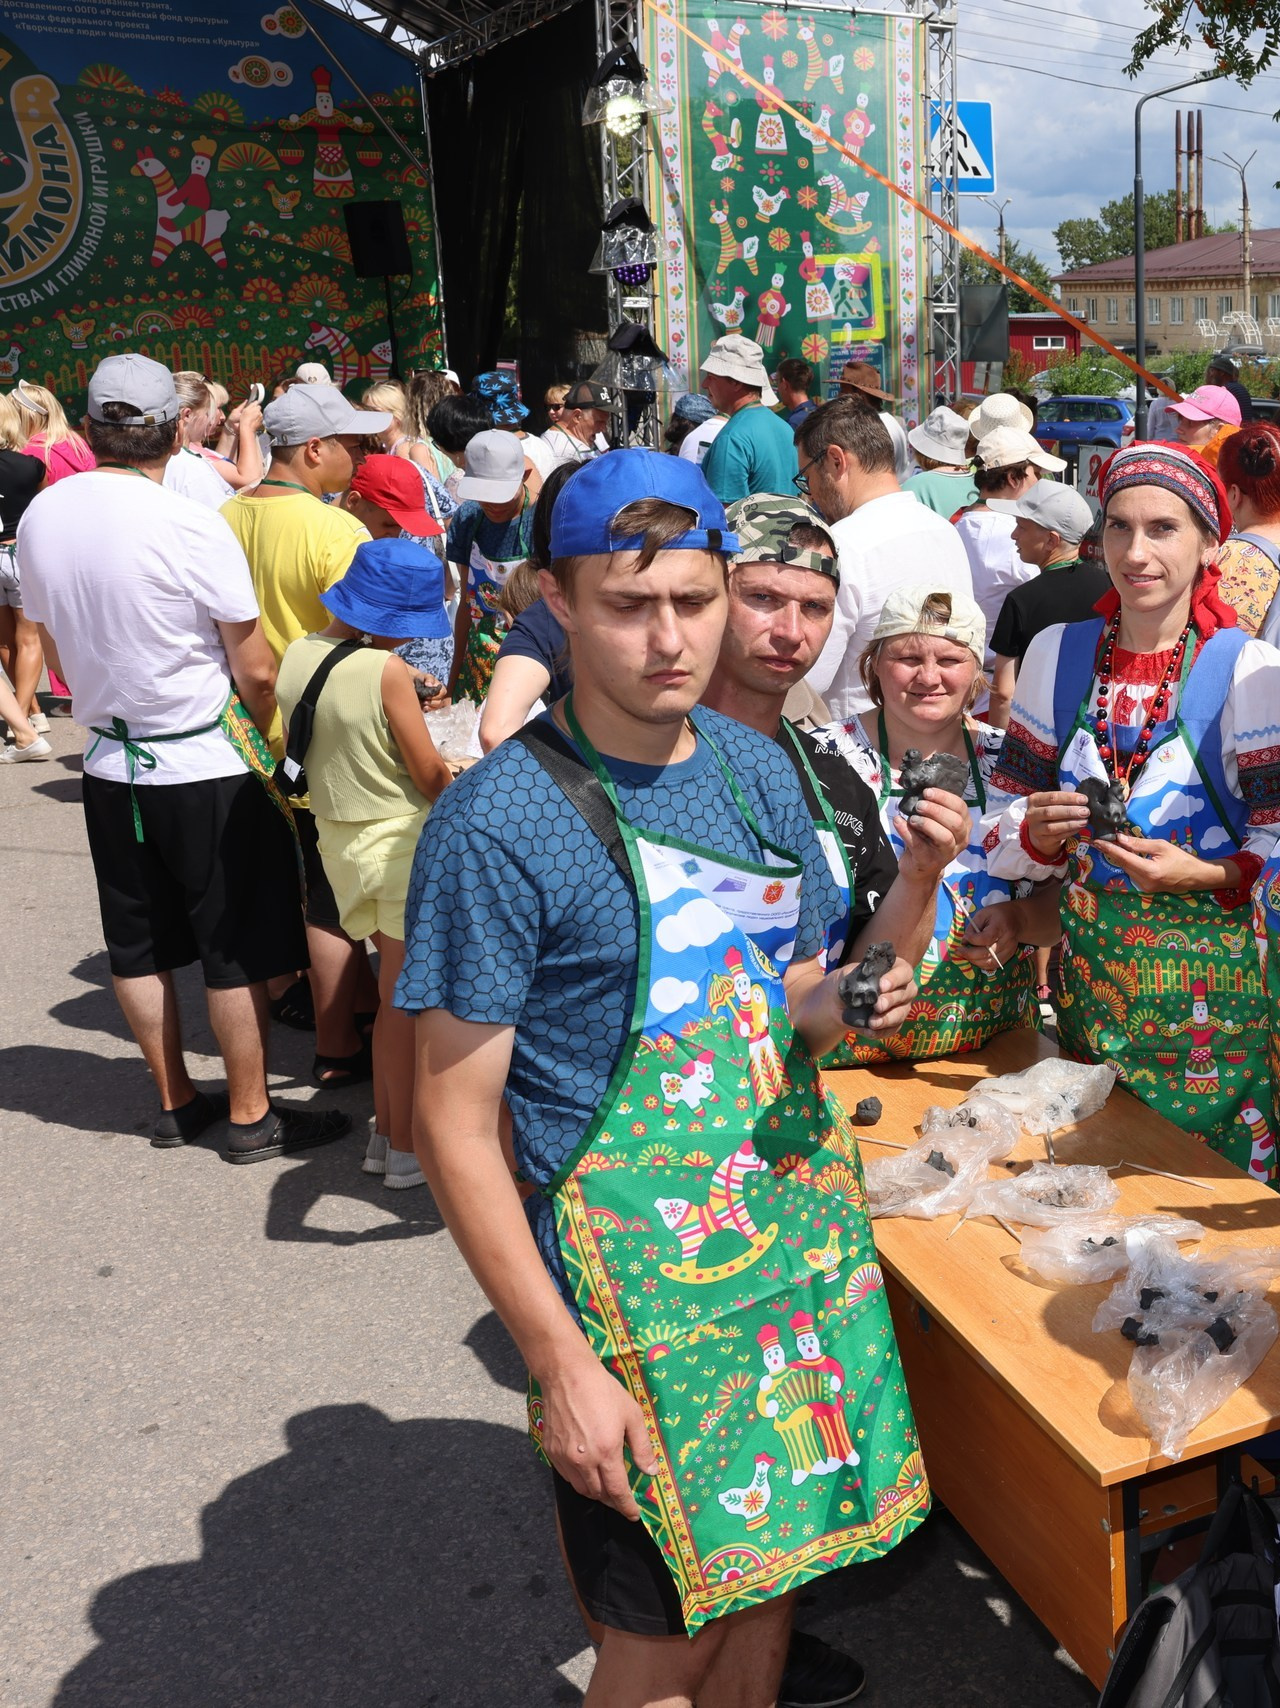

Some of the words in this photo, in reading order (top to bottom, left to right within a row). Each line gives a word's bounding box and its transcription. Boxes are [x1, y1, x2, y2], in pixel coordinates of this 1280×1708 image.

[74, 5, 98, 15] ООГО
[100, 8, 158, 19] «Российский
[160, 13, 183, 23] фонд
[184, 15, 229, 26] культуры»
[141, 2, 172, 11] гранта,
[12, 12, 46, 20] рамках
[47, 14, 113, 27] федерального
[115, 21, 150, 30] проекта
[15, 22, 75, 35] «Творческие
[77, 29, 107, 38] люди»
[109, 31, 175, 42] национального
[177, 36, 211, 45] проекта
[212, 37, 260, 49] «Культура»
[73, 111, 109, 198] ИГРУШКИ
[55, 202, 108, 287] ГЛИНЯНОЙ
[41, 279, 60, 297] И
